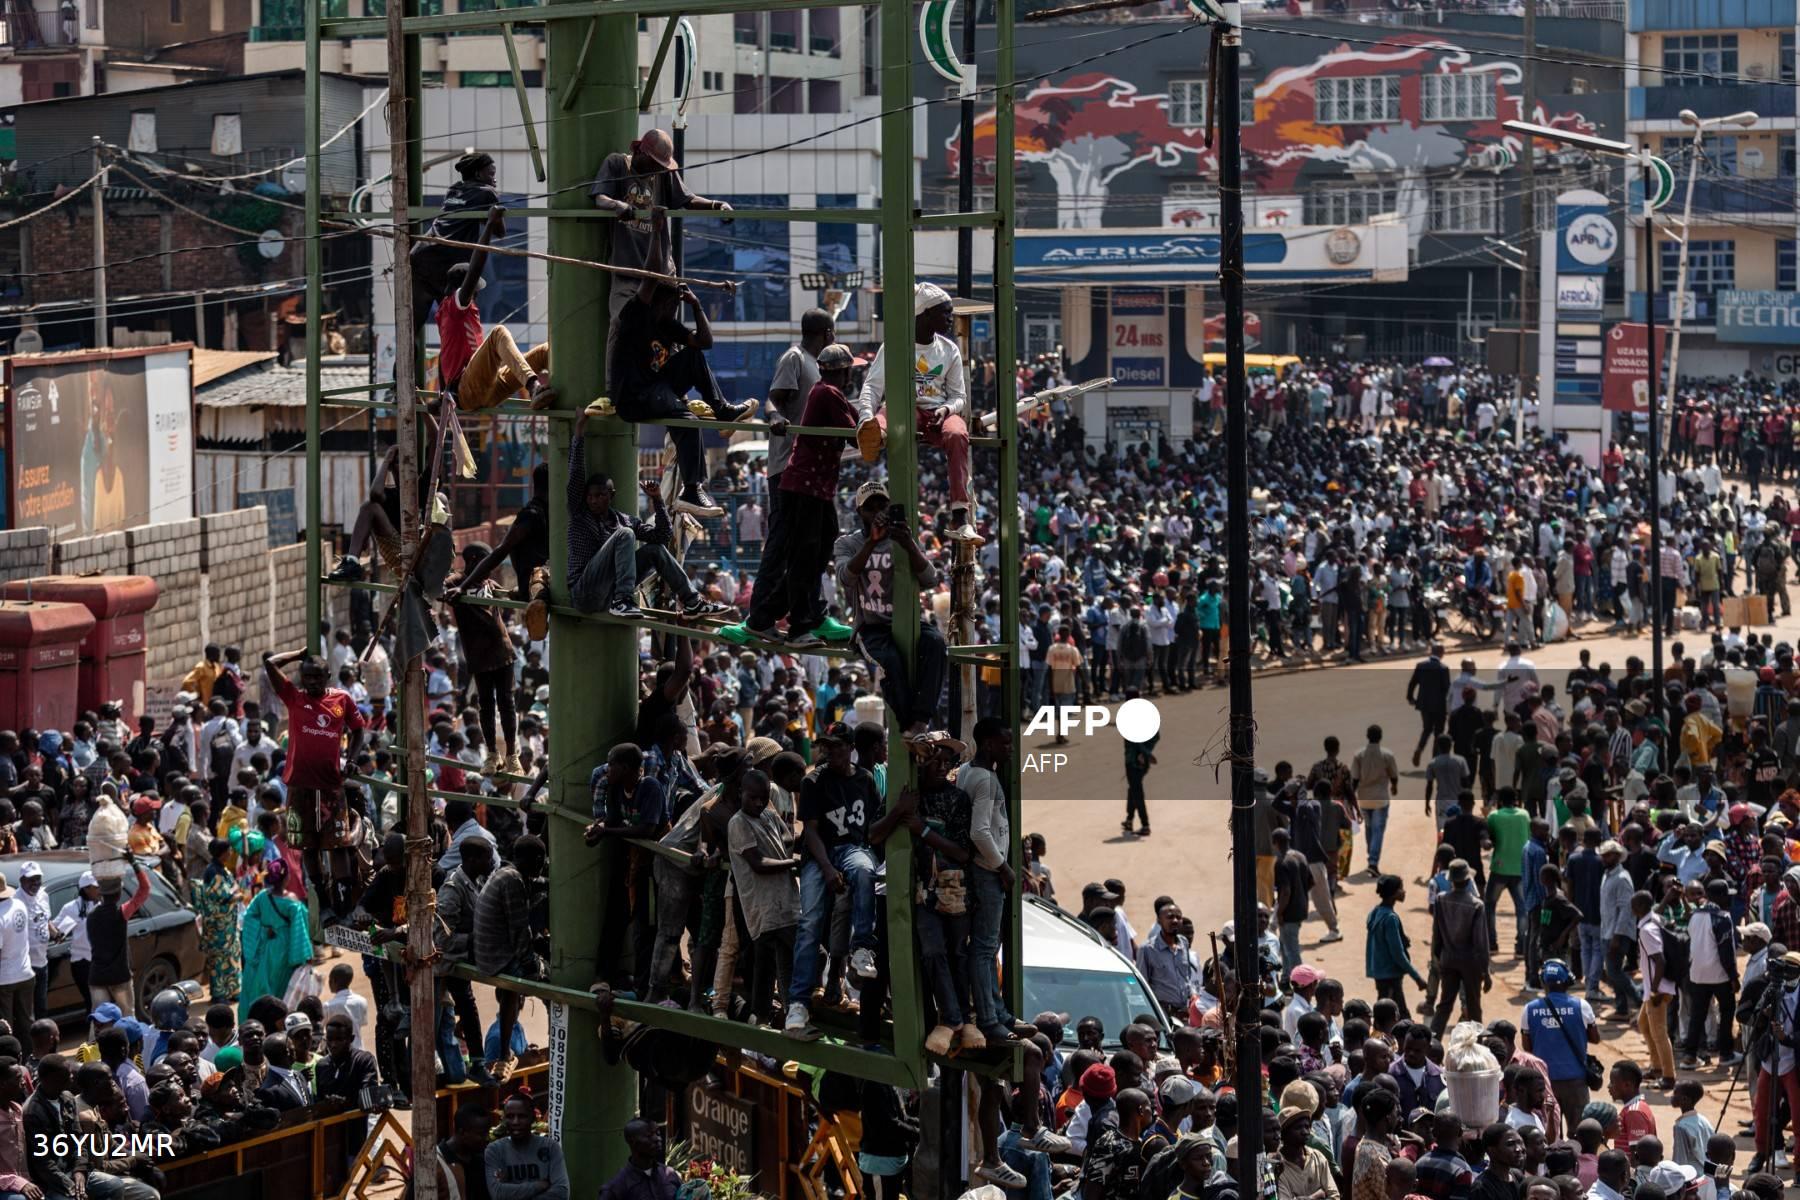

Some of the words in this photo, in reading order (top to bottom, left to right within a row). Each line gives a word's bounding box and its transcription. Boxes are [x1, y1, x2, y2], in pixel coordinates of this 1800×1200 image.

[1570, 233, 1596, 245] APB
[1043, 245, 1199, 258] AFRICA
[1559, 290, 1594, 304] AFRICA
[1763, 291, 1795, 306] SHOP
[1115, 324, 1139, 347] 24
[1140, 333, 1164, 347] HRS
[1616, 347, 1635, 356] UZA
[1611, 358, 1648, 366] VODACO
[1115, 366, 1161, 381] Diesel
[18, 464, 50, 490] Assurez
[19, 492, 42, 520] votre
[42, 480, 75, 520] quotidien
[825, 799, 865, 837] Y-3
[335, 926, 371, 944] 0971542
[553, 1028, 566, 1142] 083599515
[692, 1086, 748, 1137] Orange
[691, 1121, 747, 1172] Energie
